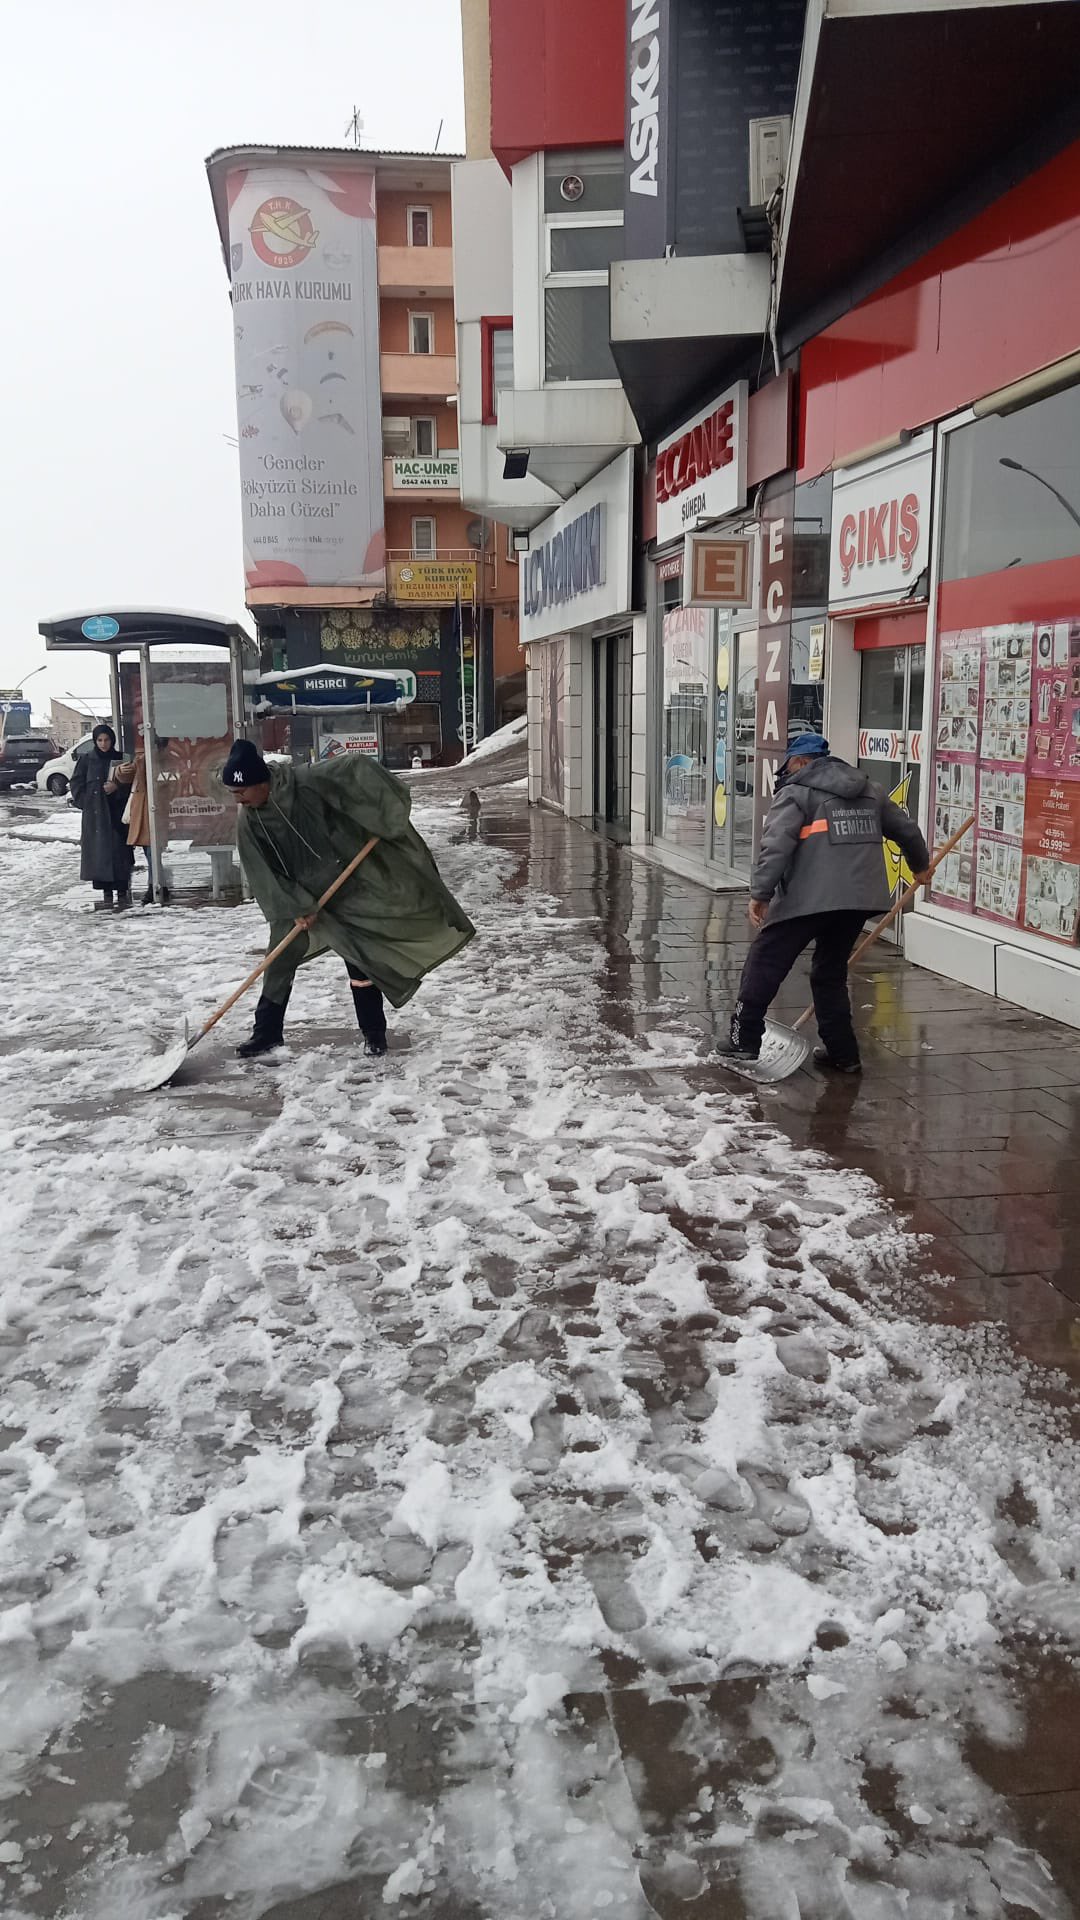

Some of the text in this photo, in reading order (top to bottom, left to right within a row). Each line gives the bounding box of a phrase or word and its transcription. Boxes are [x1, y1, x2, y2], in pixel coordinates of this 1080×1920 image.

[256, 281, 292, 299] HAVA
[295, 281, 352, 301] KURUMU
[655, 400, 734, 504] ECZANE
[394, 463, 458, 475] HAC-UMRE
[301, 478, 358, 496] Sizinle
[250, 502, 286, 518] Daha
[681, 492, 707, 528] ŞÜHEDA
[840, 493, 919, 586] ÇIKIŞ
[659, 559, 681, 578] APOTHEKE
[703, 550, 737, 592] E
[305, 678, 346, 690] MISIRCI
[868, 738, 889, 756] ÇIKIŞ
